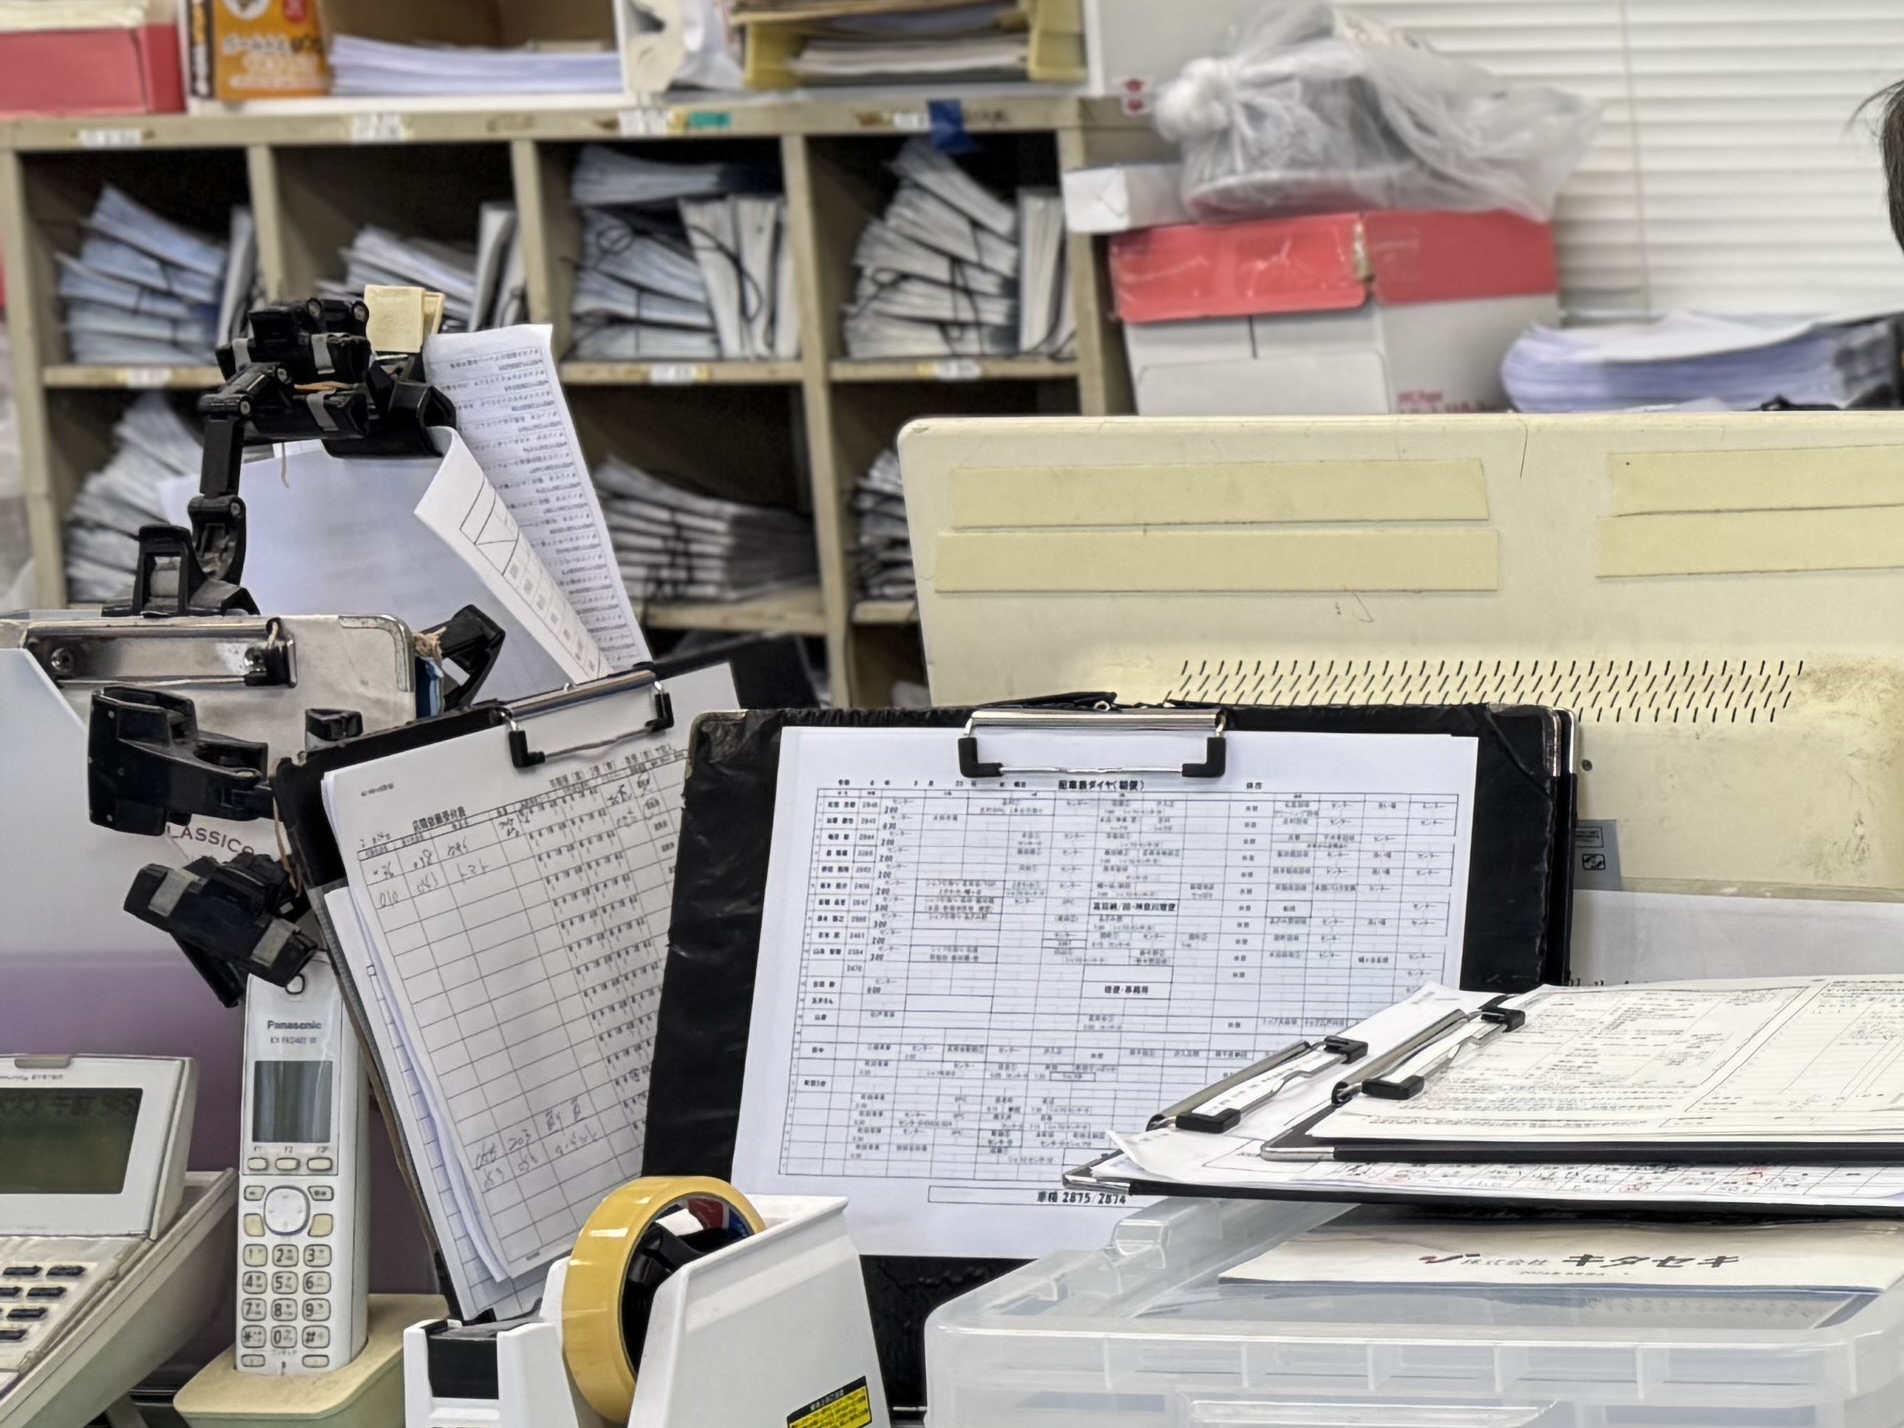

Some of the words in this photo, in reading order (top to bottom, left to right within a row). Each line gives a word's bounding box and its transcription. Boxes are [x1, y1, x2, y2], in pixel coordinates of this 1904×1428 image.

[267, 1019, 322, 1032] Panasonic
[1562, 1253, 1740, 1269] キタセキ
